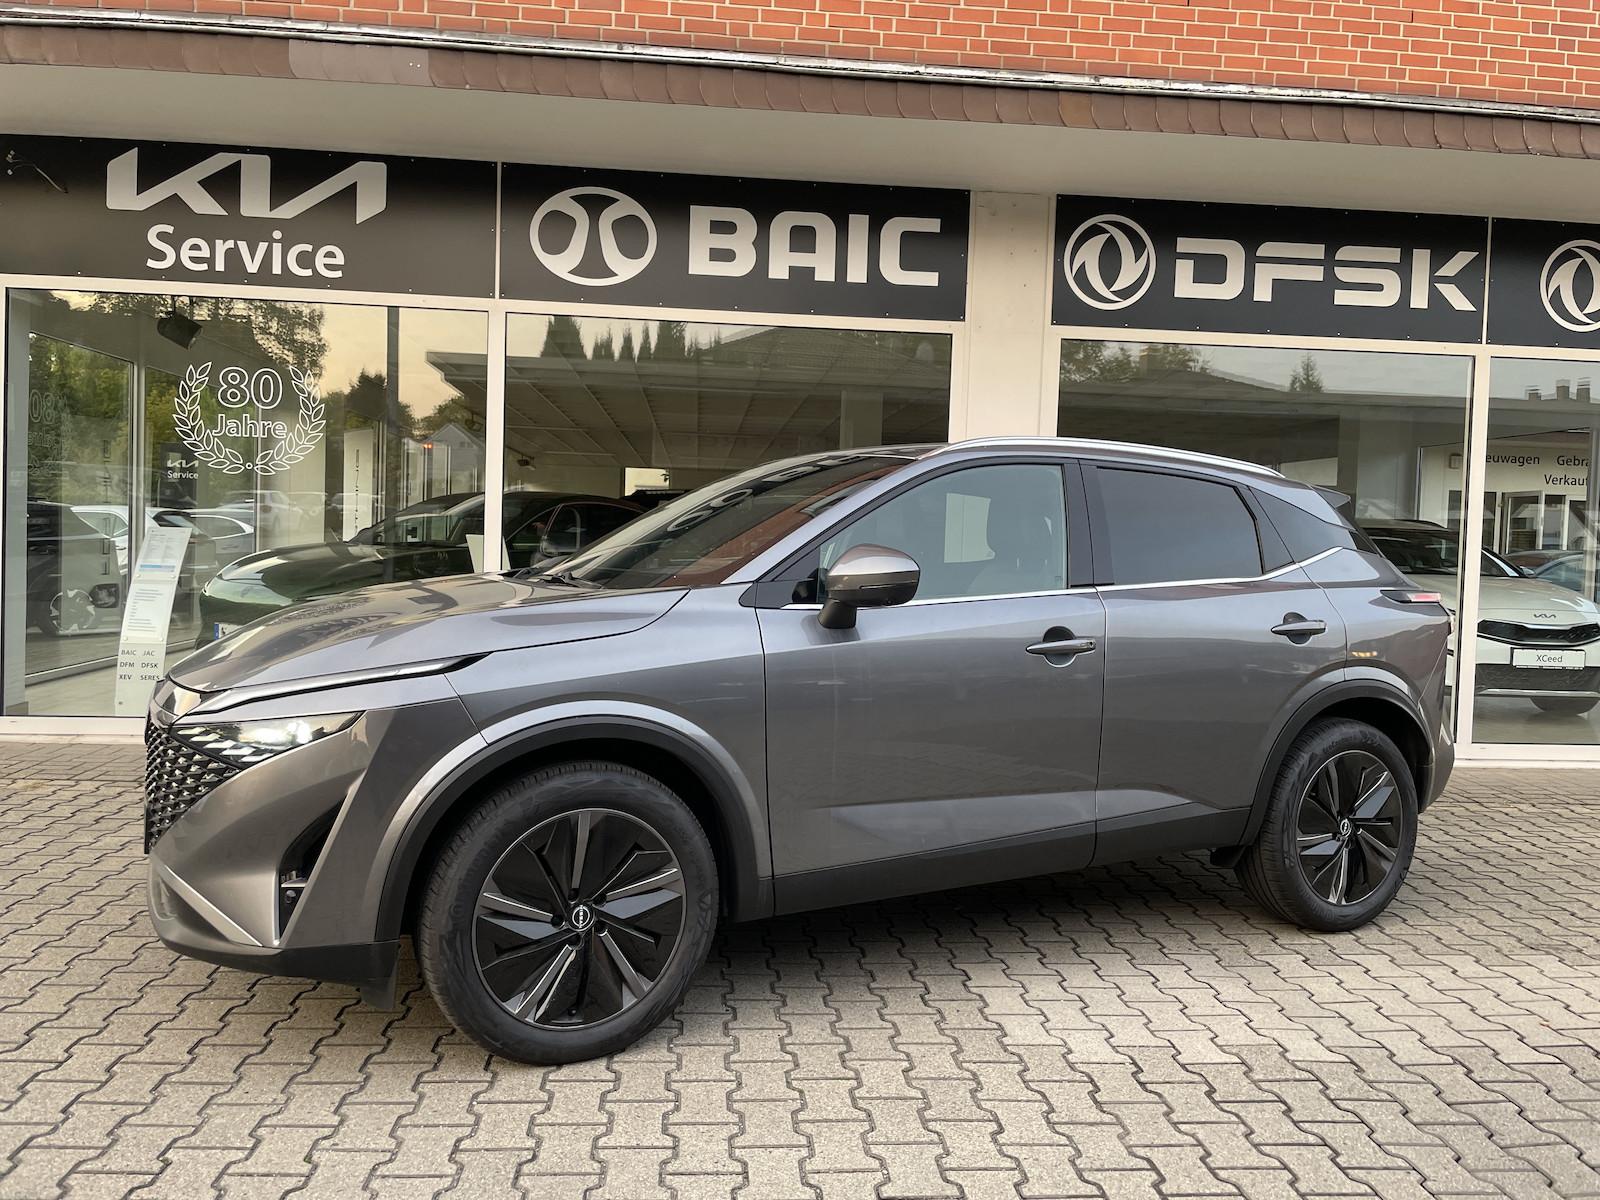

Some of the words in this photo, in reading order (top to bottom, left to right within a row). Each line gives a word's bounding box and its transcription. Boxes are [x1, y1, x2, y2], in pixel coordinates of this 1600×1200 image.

[106, 147, 388, 225] KIA
[146, 223, 345, 278] Service
[688, 205, 942, 287] BAIC
[1174, 237, 1480, 312] DFSK
[218, 366, 283, 410] 80
[212, 413, 288, 439] Jahre
[167, 470, 199, 479] Service
[1485, 454, 1540, 467] euwagen
[1544, 474, 1588, 486] Verkau
[1536, 654, 1563, 663] XCeed
